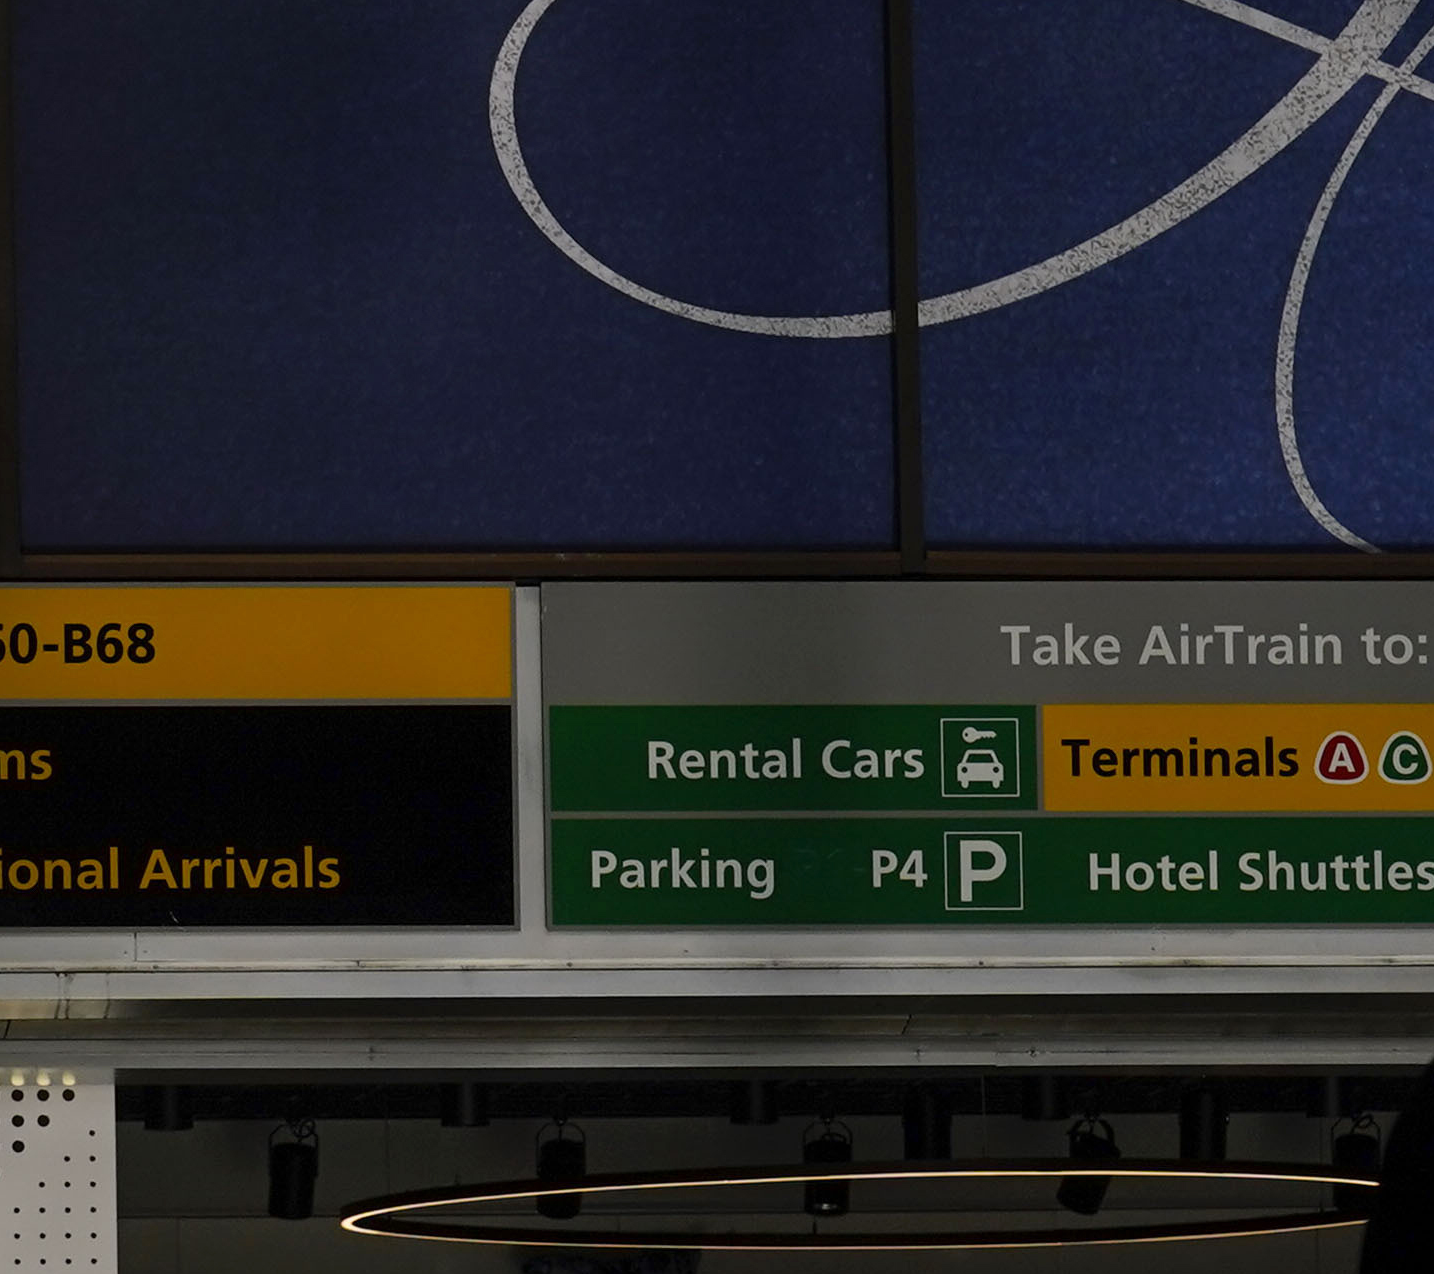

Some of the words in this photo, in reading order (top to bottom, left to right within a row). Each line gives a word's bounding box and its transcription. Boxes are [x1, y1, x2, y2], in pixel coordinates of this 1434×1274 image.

[1000, 623, 1120, 665] Take
[1139, 623, 1341, 664] AirTrain
[1361, 628, 1427, 664] to:
[648, 738, 801, 779] Rental
[822, 740, 924, 778] Cars
[1061, 736, 1299, 777] Terminals
[1328, 744, 1354, 772] A
[1393, 744, 1419, 773] C
[140, 846, 340, 888] Arrivals
[592, 848, 774, 899] Parking
[873, 850, 927, 887] P4
[1090, 850, 1217, 890] Hotel
